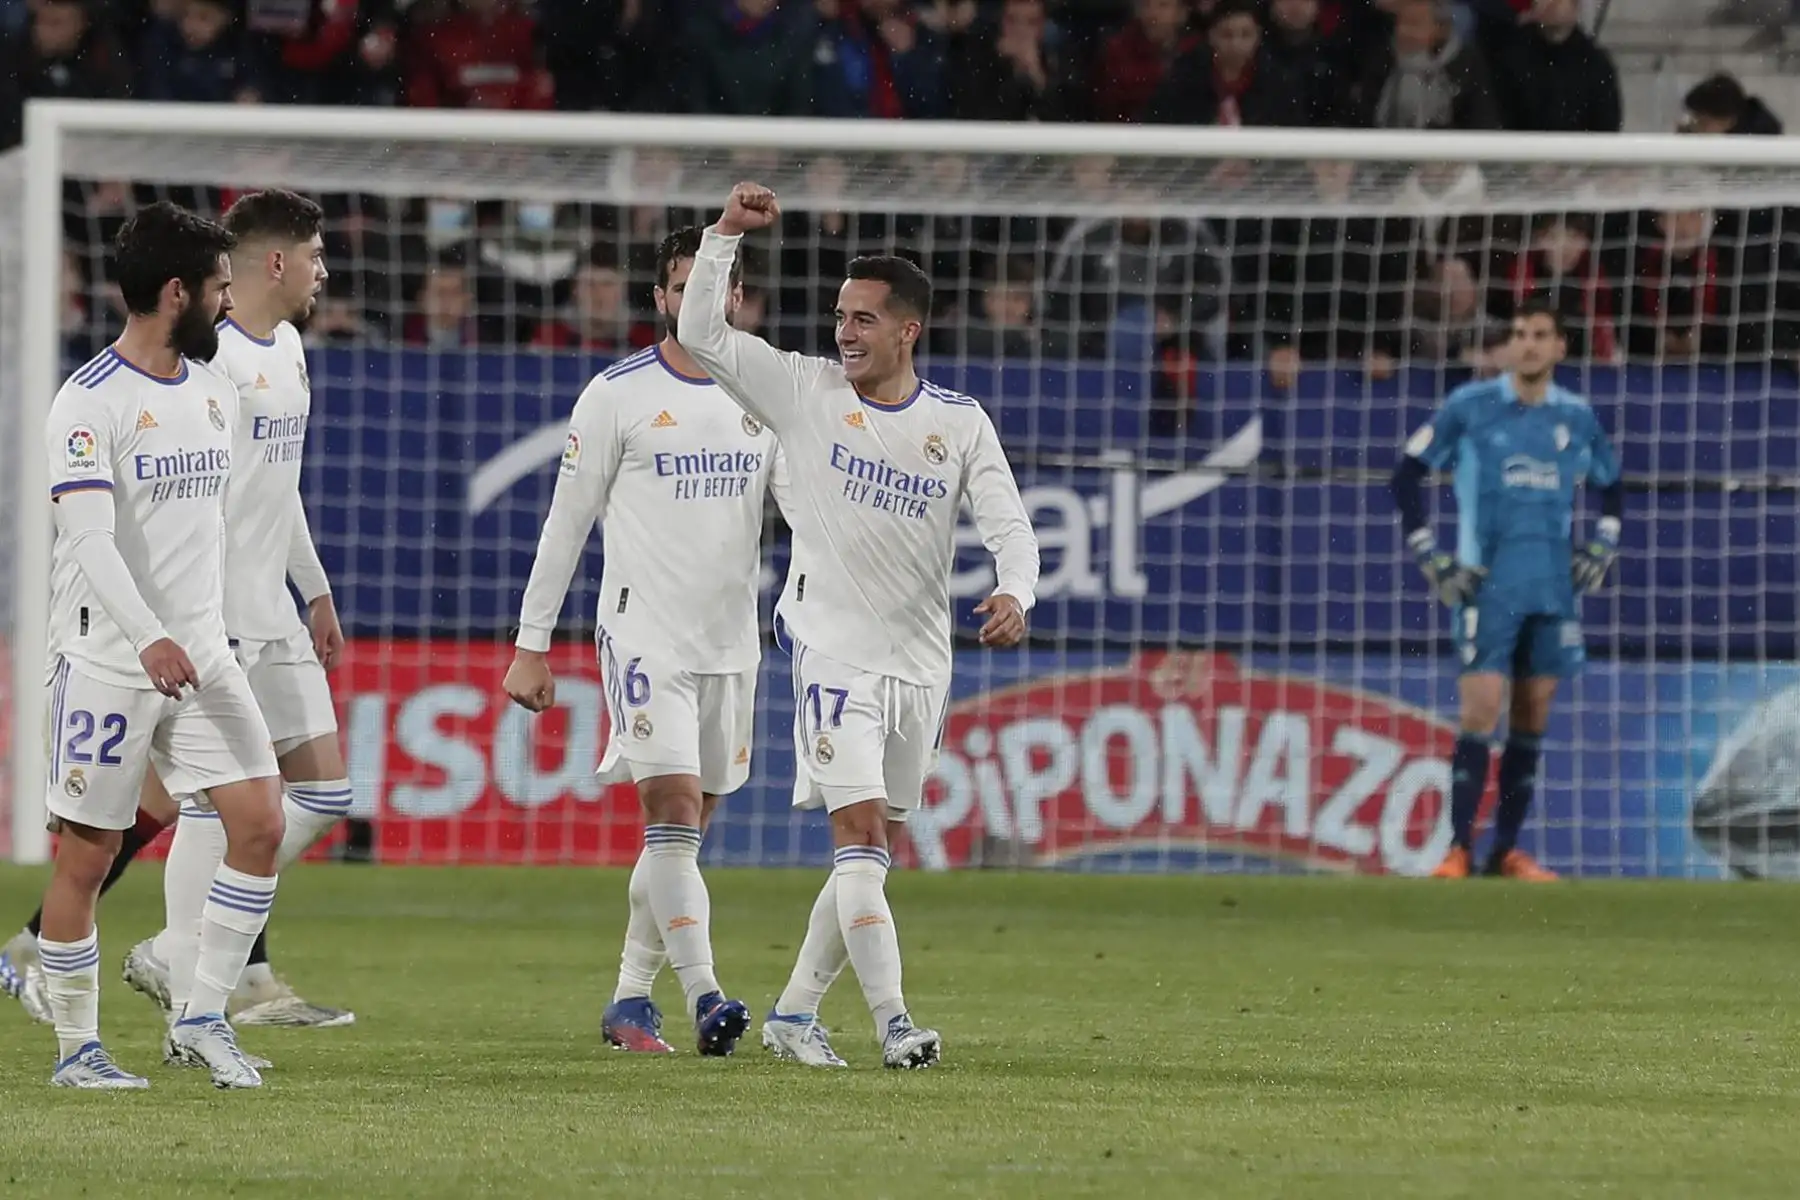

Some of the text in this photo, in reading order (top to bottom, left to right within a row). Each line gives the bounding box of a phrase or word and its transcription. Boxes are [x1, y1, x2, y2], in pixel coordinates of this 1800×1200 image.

[134, 448, 230, 481] Emirates
[655, 448, 762, 477] Emirates
[830, 443, 948, 500] Emirates
[152, 475, 222, 503] FLY BETTER
[675, 476, 748, 499] FLY BETTER
[843, 479, 928, 520] FLY BETTER
[624, 657, 651, 708] 6
[806, 683, 849, 733] 17
[63, 709, 129, 768] 22
